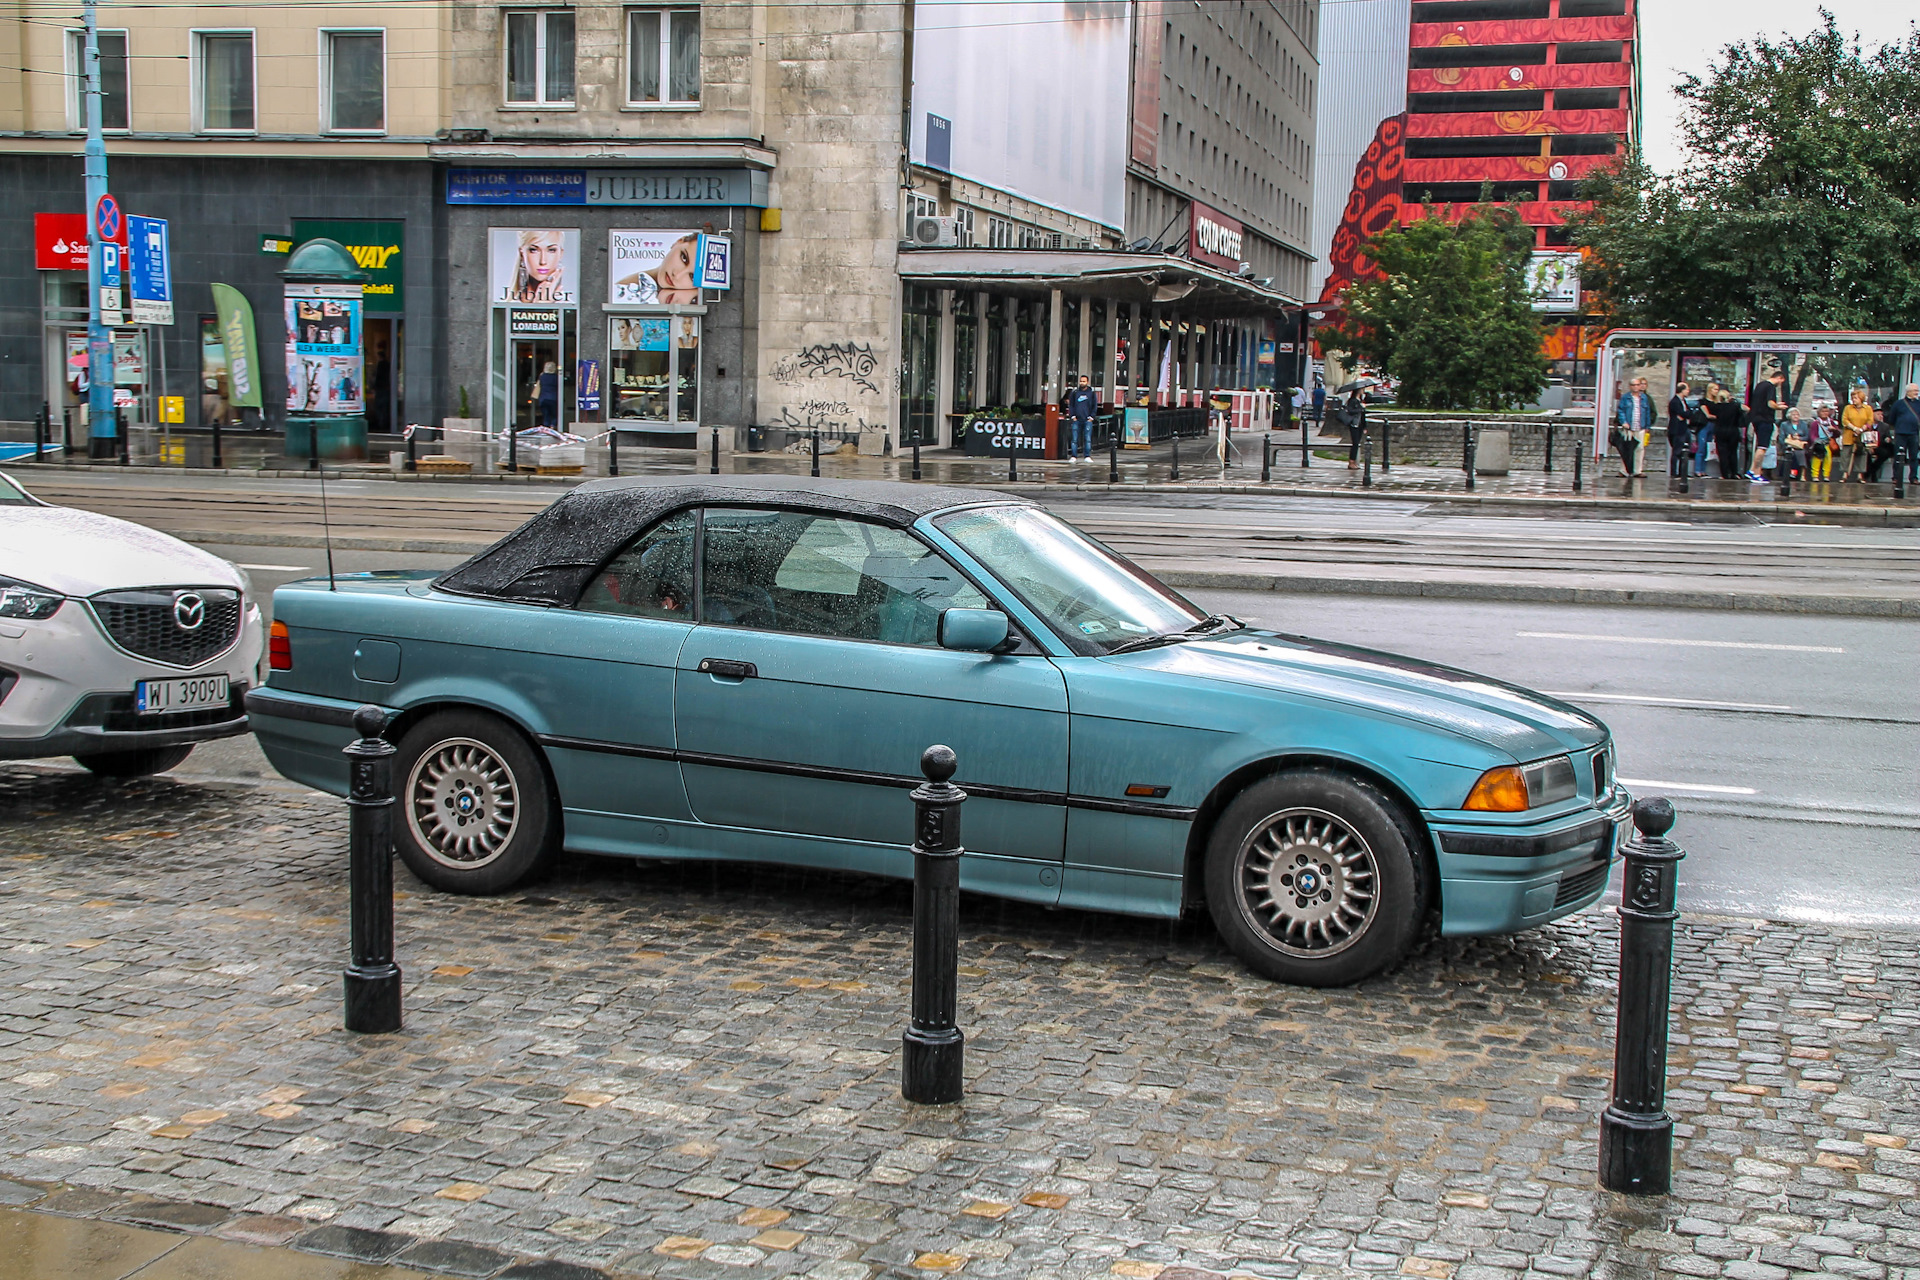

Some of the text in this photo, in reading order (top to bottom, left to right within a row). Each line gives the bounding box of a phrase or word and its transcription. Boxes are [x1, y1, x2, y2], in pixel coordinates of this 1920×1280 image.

[932, 117, 946, 130] 1856
[452, 174, 583, 184] KANTOR LOMBARD
[589, 176, 726, 200] JUBILER
[614, 235, 643, 248] ROSY
[1197, 216, 1242, 261] COSTA COFFEE
[617, 247, 666, 260] DIAMONDS
[708, 243, 726, 255] KANTOR
[345, 244, 400, 269] WAY
[708, 253, 723, 271] 24h
[706, 269, 726, 281] LOMBARD
[500, 287, 573, 302] Jubiler
[512, 311, 557, 321] KANTOR
[512, 322, 558, 331] LOMBARD
[973, 420, 1025, 436] COSTA
[149, 678, 226, 707] WI 3909U
